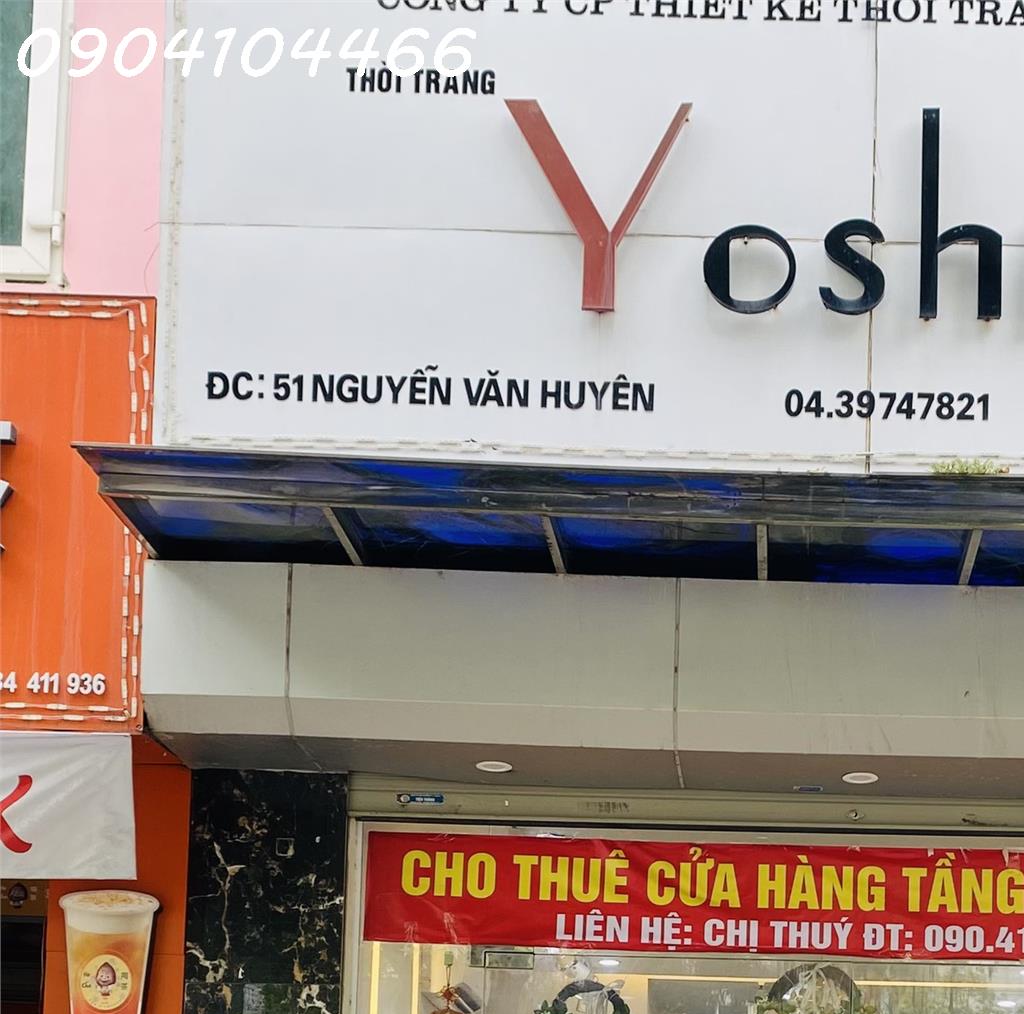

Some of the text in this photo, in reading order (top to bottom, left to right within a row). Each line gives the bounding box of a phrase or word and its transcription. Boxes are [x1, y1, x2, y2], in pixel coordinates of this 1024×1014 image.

[414, 69, 495, 95] TRANG
[205, 364, 655, 411] ĐC: 51 NGUYỄN VĂN HUYÊN
[784, 388, 990, 421] 04.39747821
[27, 672, 59, 694] 411
[66, 672, 106, 695] 936
[402, 850, 497, 899] CHO
[513, 850, 629, 904] THUÊ
[646, 846, 740, 908] CỬA
[758, 854, 885, 912] HÀNG
[902, 852, 1024, 915] TẦNG
[556, 910, 629, 943] LIÊN
[641, 912, 692, 951] HỆ:
[704, 919, 757, 953] CHỊ
[770, 917, 853, 950] THUÝ
[863, 923, 913, 952] ĐT:
